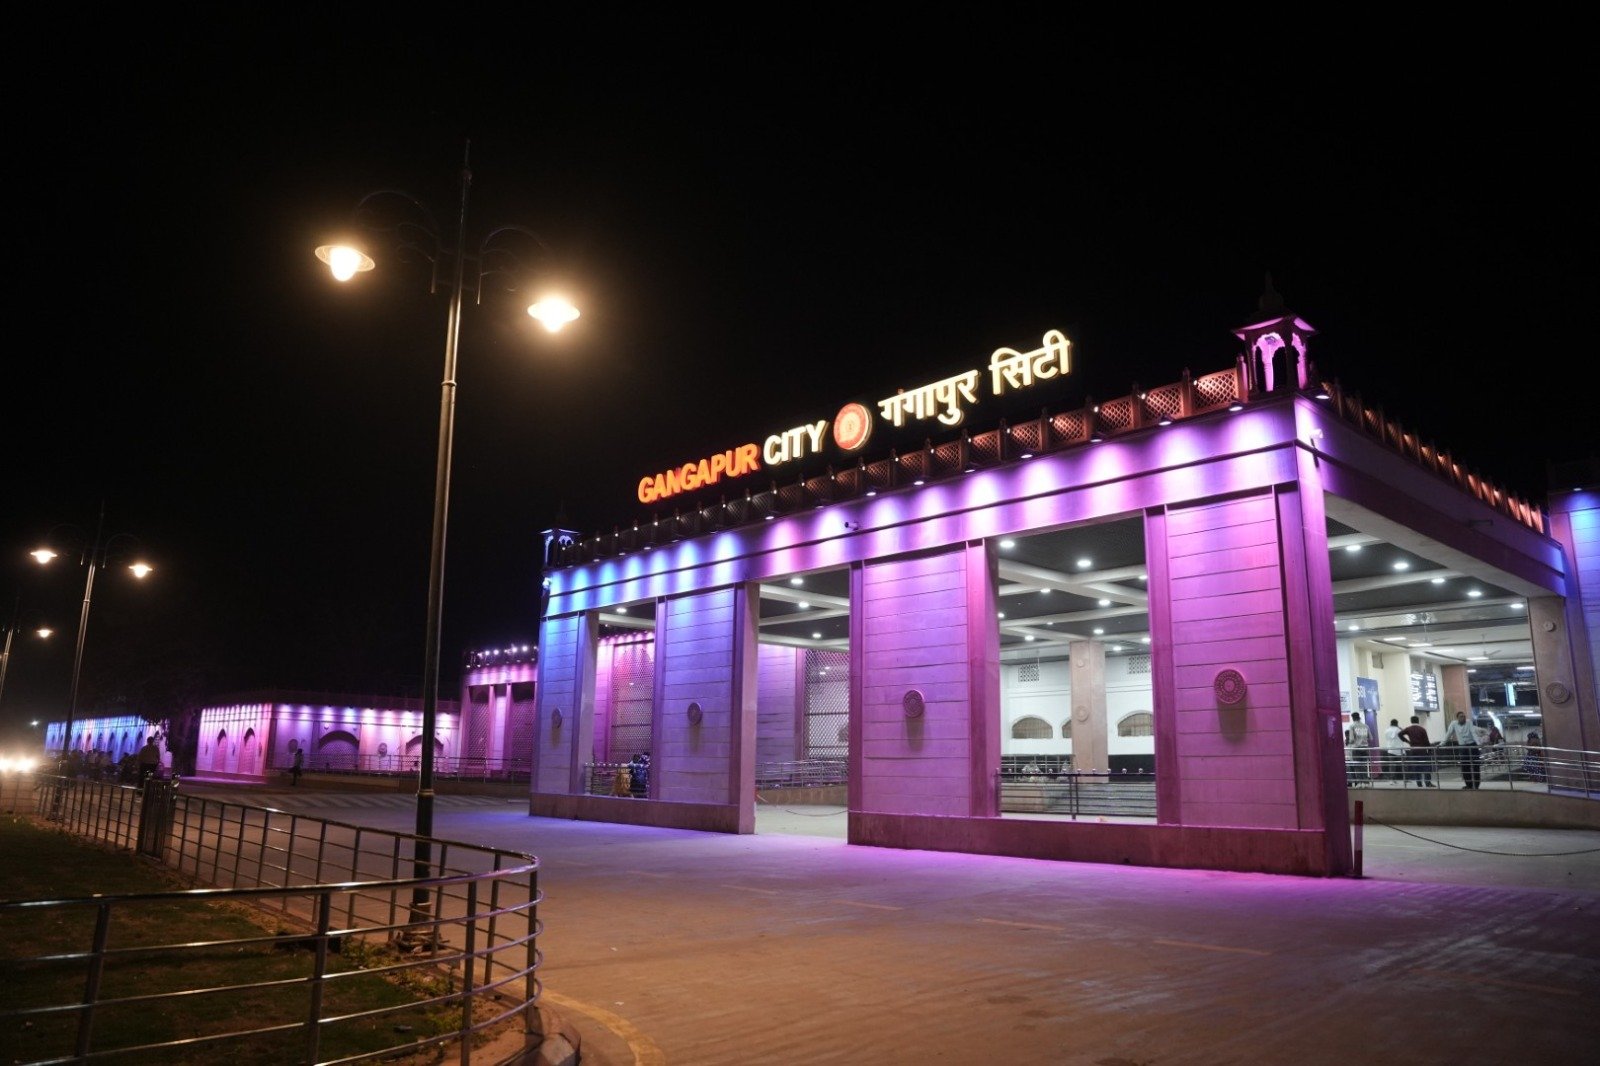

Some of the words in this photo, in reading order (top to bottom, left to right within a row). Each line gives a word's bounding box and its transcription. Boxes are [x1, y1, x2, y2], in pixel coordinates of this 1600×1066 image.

[988, 329, 1072, 396] सिटी
[637, 444, 760, 504] GANGAPUR
[763, 419, 827, 466] CITY
